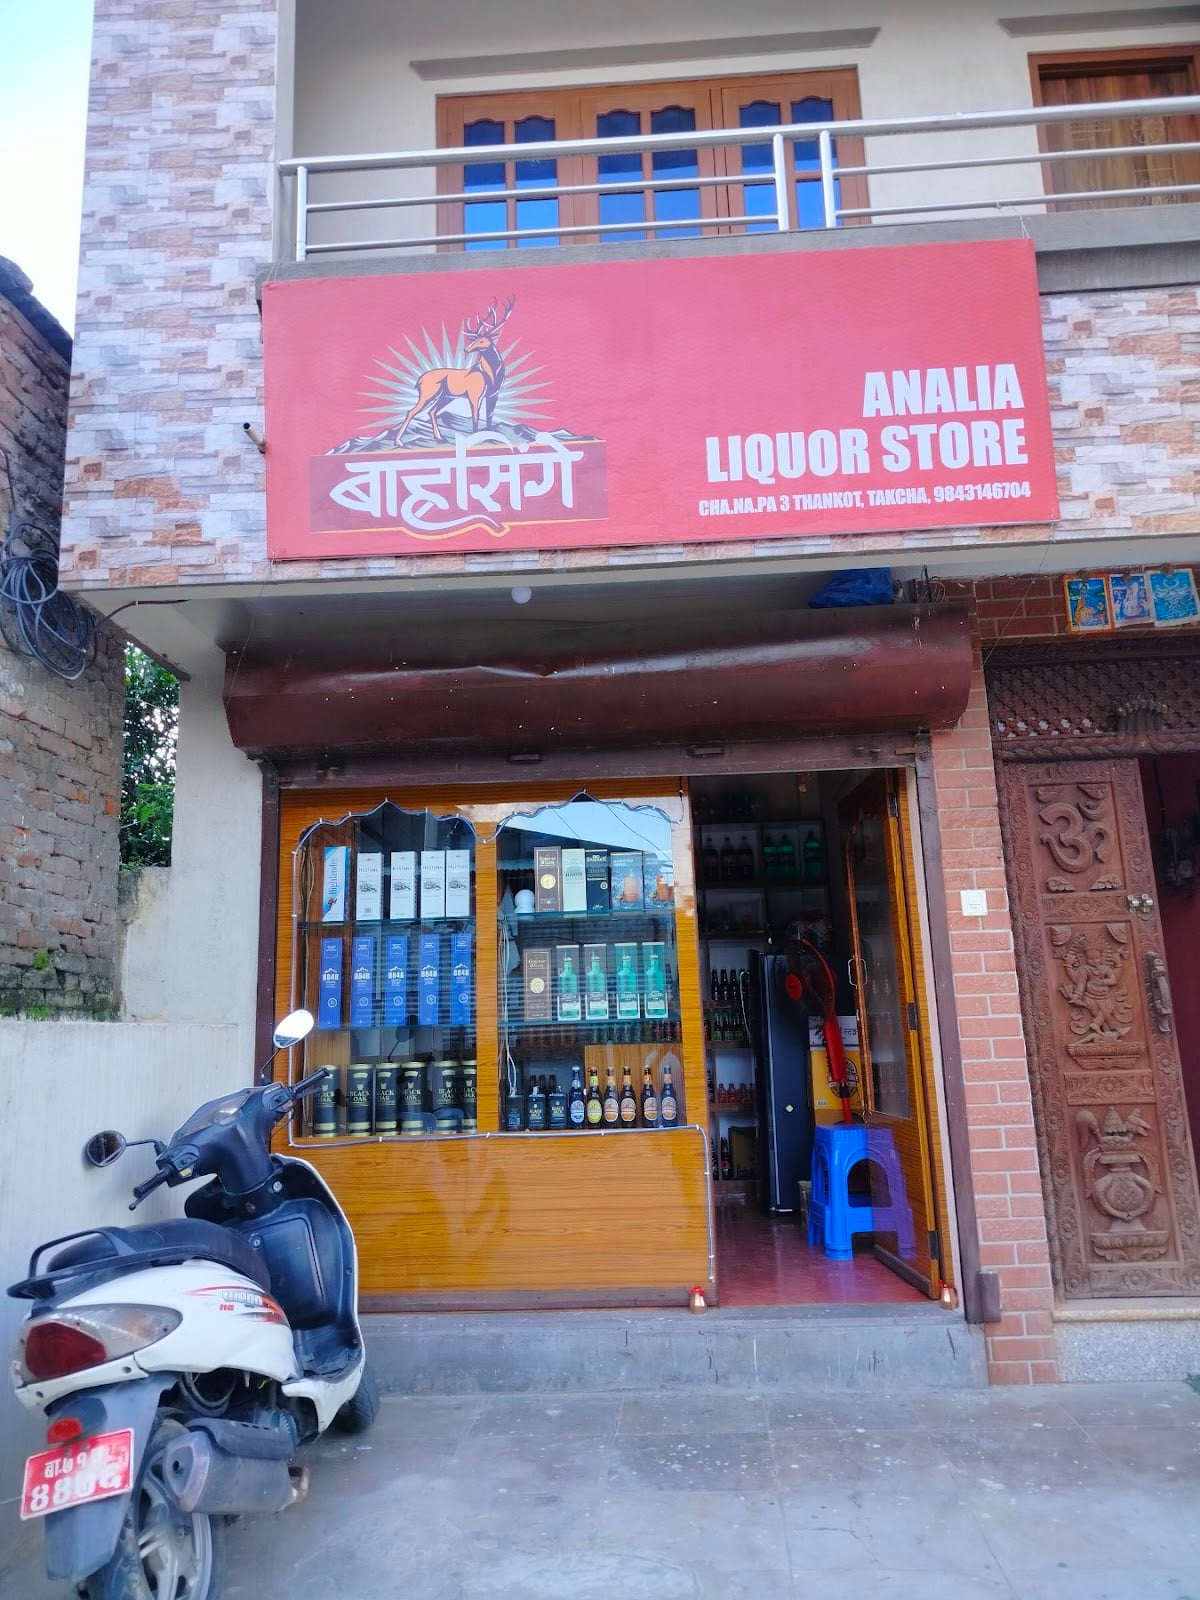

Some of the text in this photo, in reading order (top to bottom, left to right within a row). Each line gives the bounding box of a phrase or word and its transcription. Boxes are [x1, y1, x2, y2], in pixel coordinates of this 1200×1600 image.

[862, 363, 1025, 417] ANALIA
[705, 418, 1029, 485] LIQUOR STORE
[698, 498, 777, 516] CHA.NA.PA
[779, 499, 790, 512] 3
[792, 491, 866, 511] THANKOT,
[933, 481, 1032, 503] 9843146704
